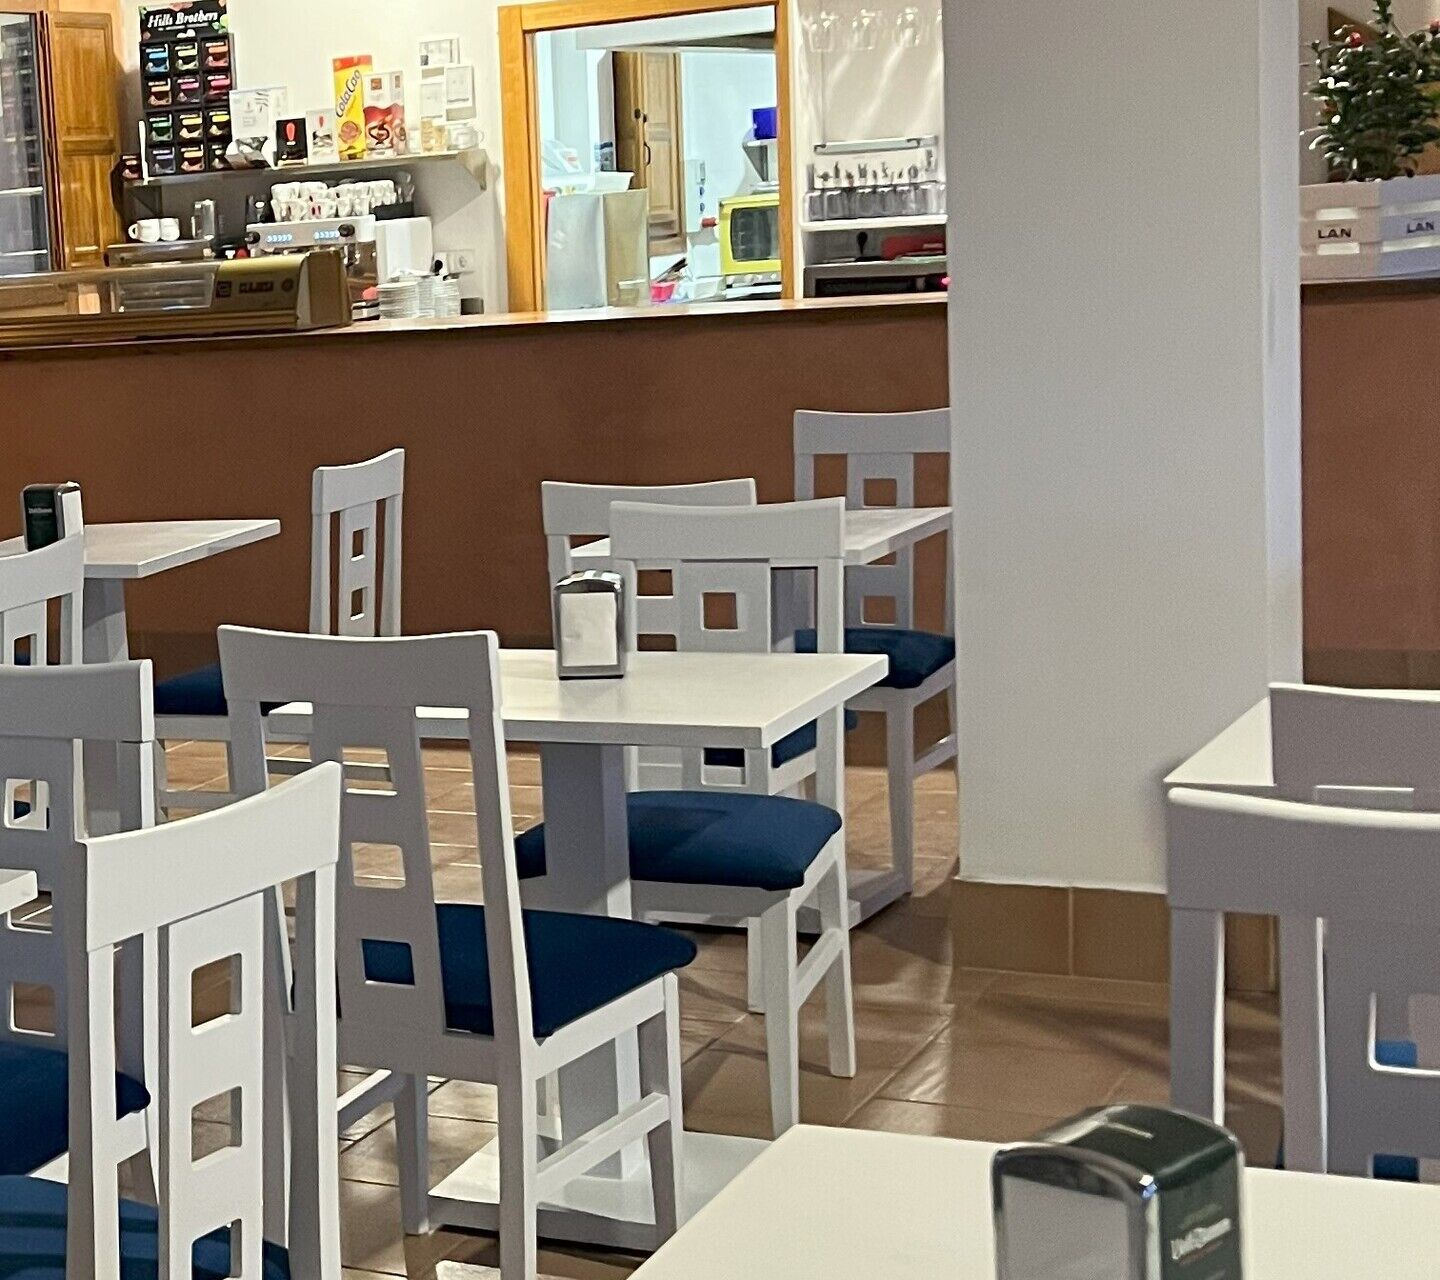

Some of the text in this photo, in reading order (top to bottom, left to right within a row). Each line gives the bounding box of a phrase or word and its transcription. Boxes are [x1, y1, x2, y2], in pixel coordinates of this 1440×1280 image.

[147, 14, 173, 28] Hills
[175, 9, 218, 25] Brothers
[336, 70, 361, 118] ColaCao
[1318, 228, 1351, 239] LAN
[1406, 221, 1434, 234] LAN
